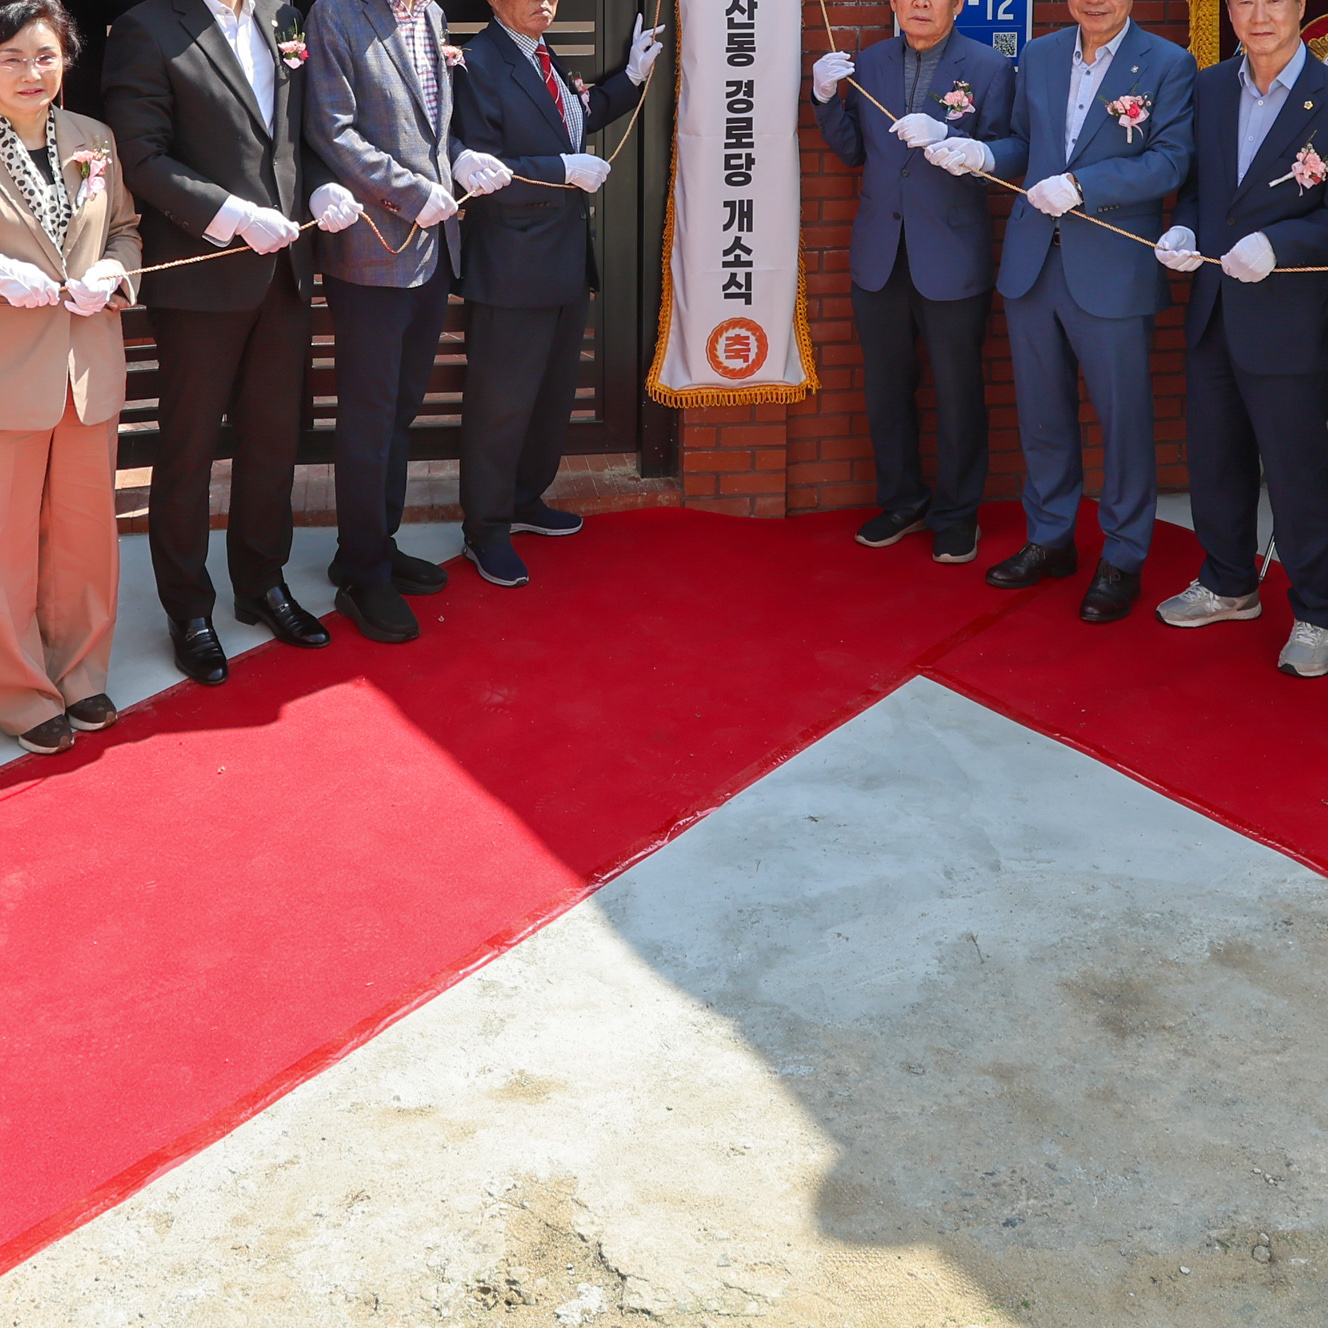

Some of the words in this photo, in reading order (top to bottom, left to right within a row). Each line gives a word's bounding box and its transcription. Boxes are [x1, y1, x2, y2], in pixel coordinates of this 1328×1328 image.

[723, 79, 756, 187] 경로당
[722, 199, 754, 306] 개소식
[723, 333, 751, 364] 축
